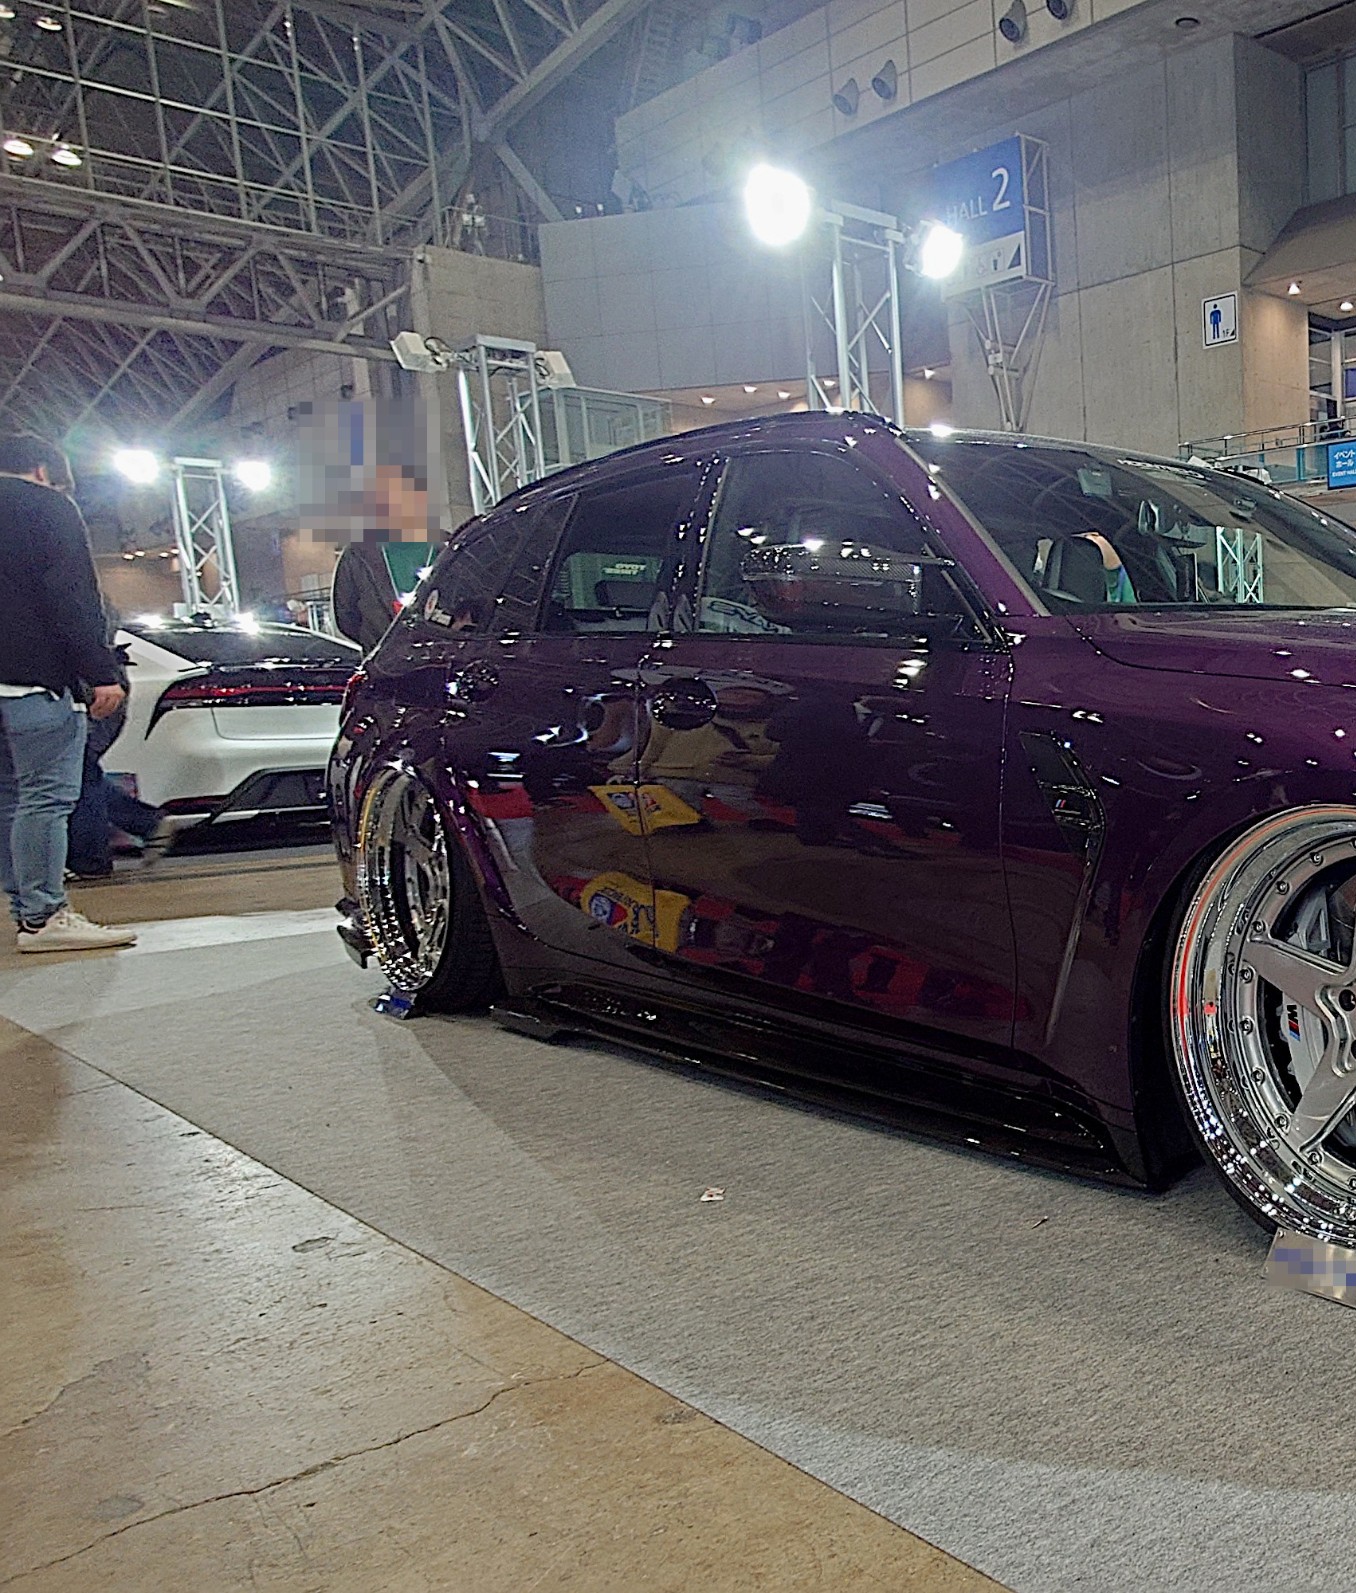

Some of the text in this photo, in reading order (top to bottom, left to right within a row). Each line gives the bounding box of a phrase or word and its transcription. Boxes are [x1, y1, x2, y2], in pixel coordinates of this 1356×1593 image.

[947, 167, 1010, 220] HALL 2
[1222, 328, 1230, 338] 1F
[1333, 449, 1356, 459] イベント
